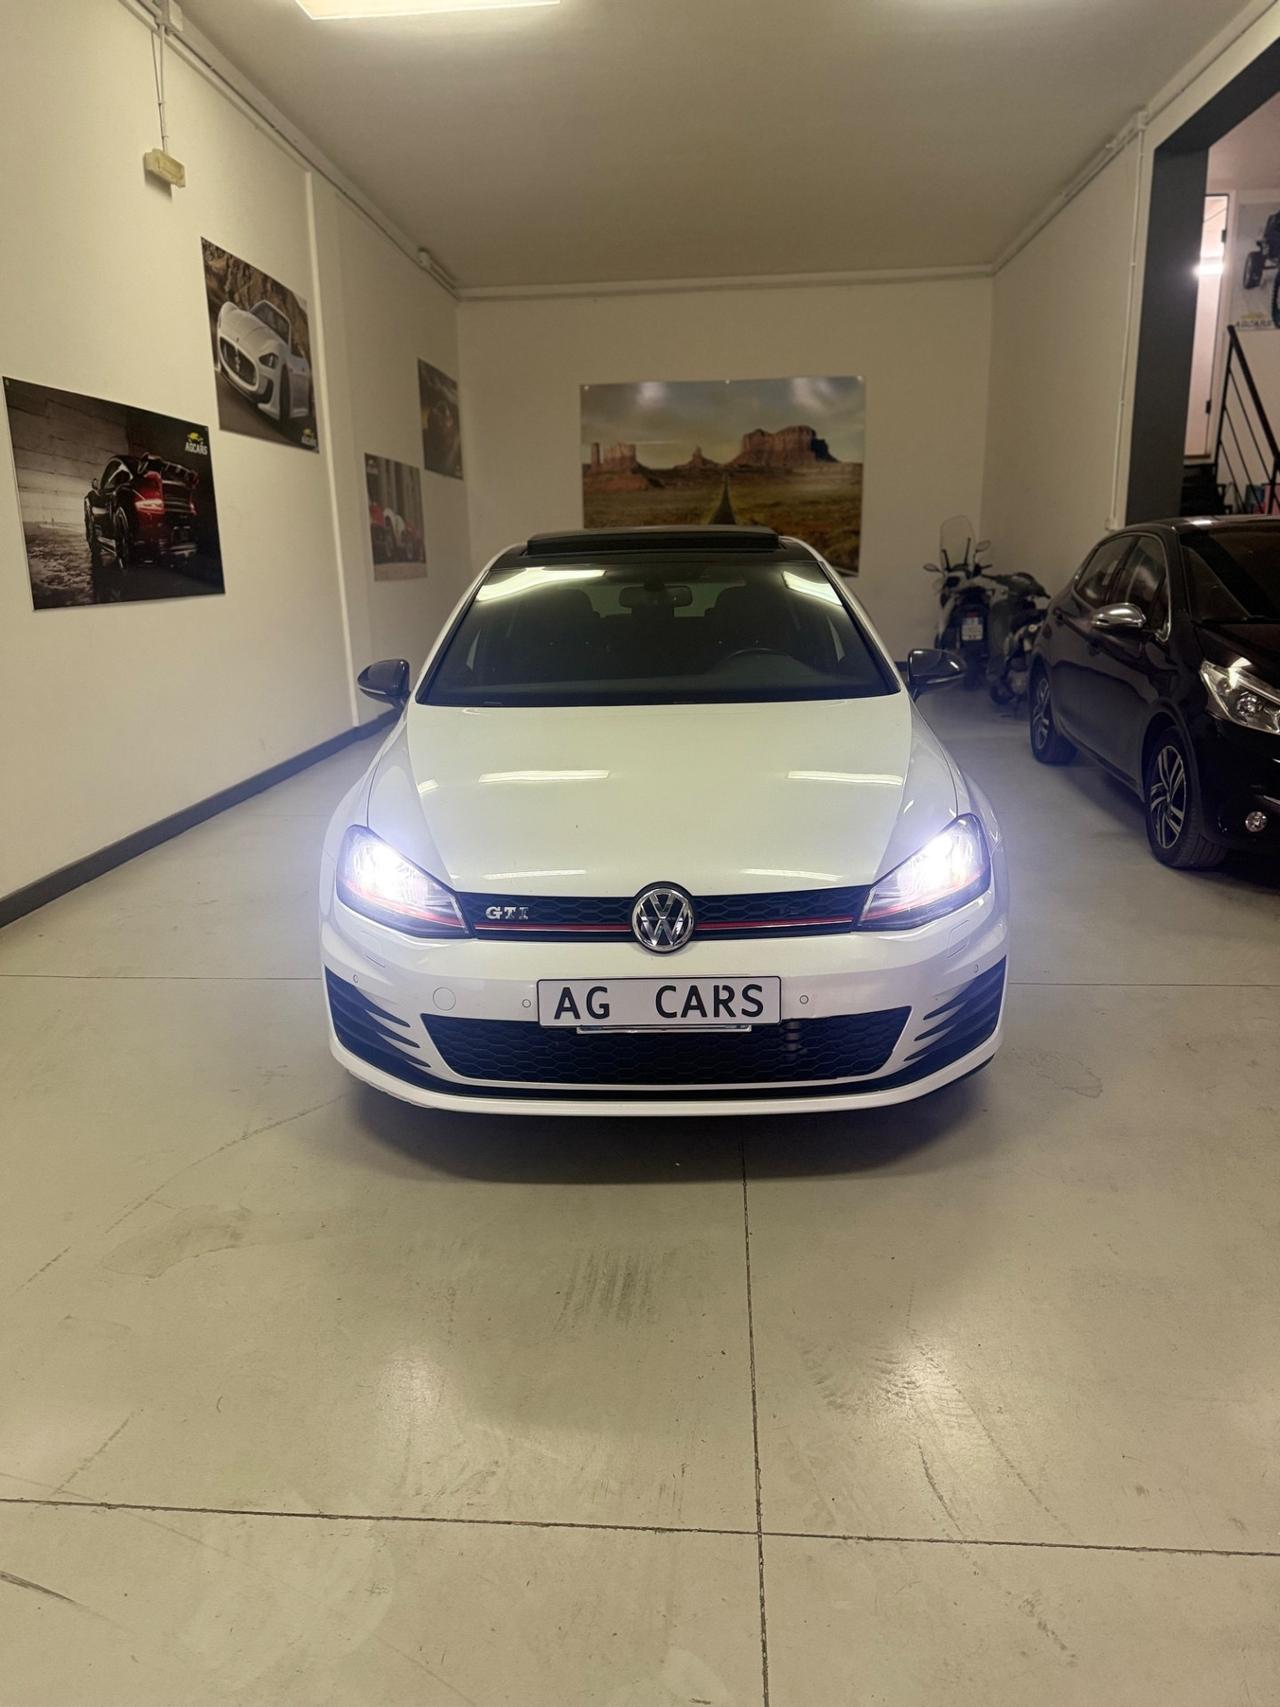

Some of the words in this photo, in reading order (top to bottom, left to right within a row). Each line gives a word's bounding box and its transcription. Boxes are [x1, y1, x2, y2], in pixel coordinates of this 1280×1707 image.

[485, 906, 529, 920] GTI
[554, 986, 610, 1020] AG
[655, 984, 764, 1018] CARS
